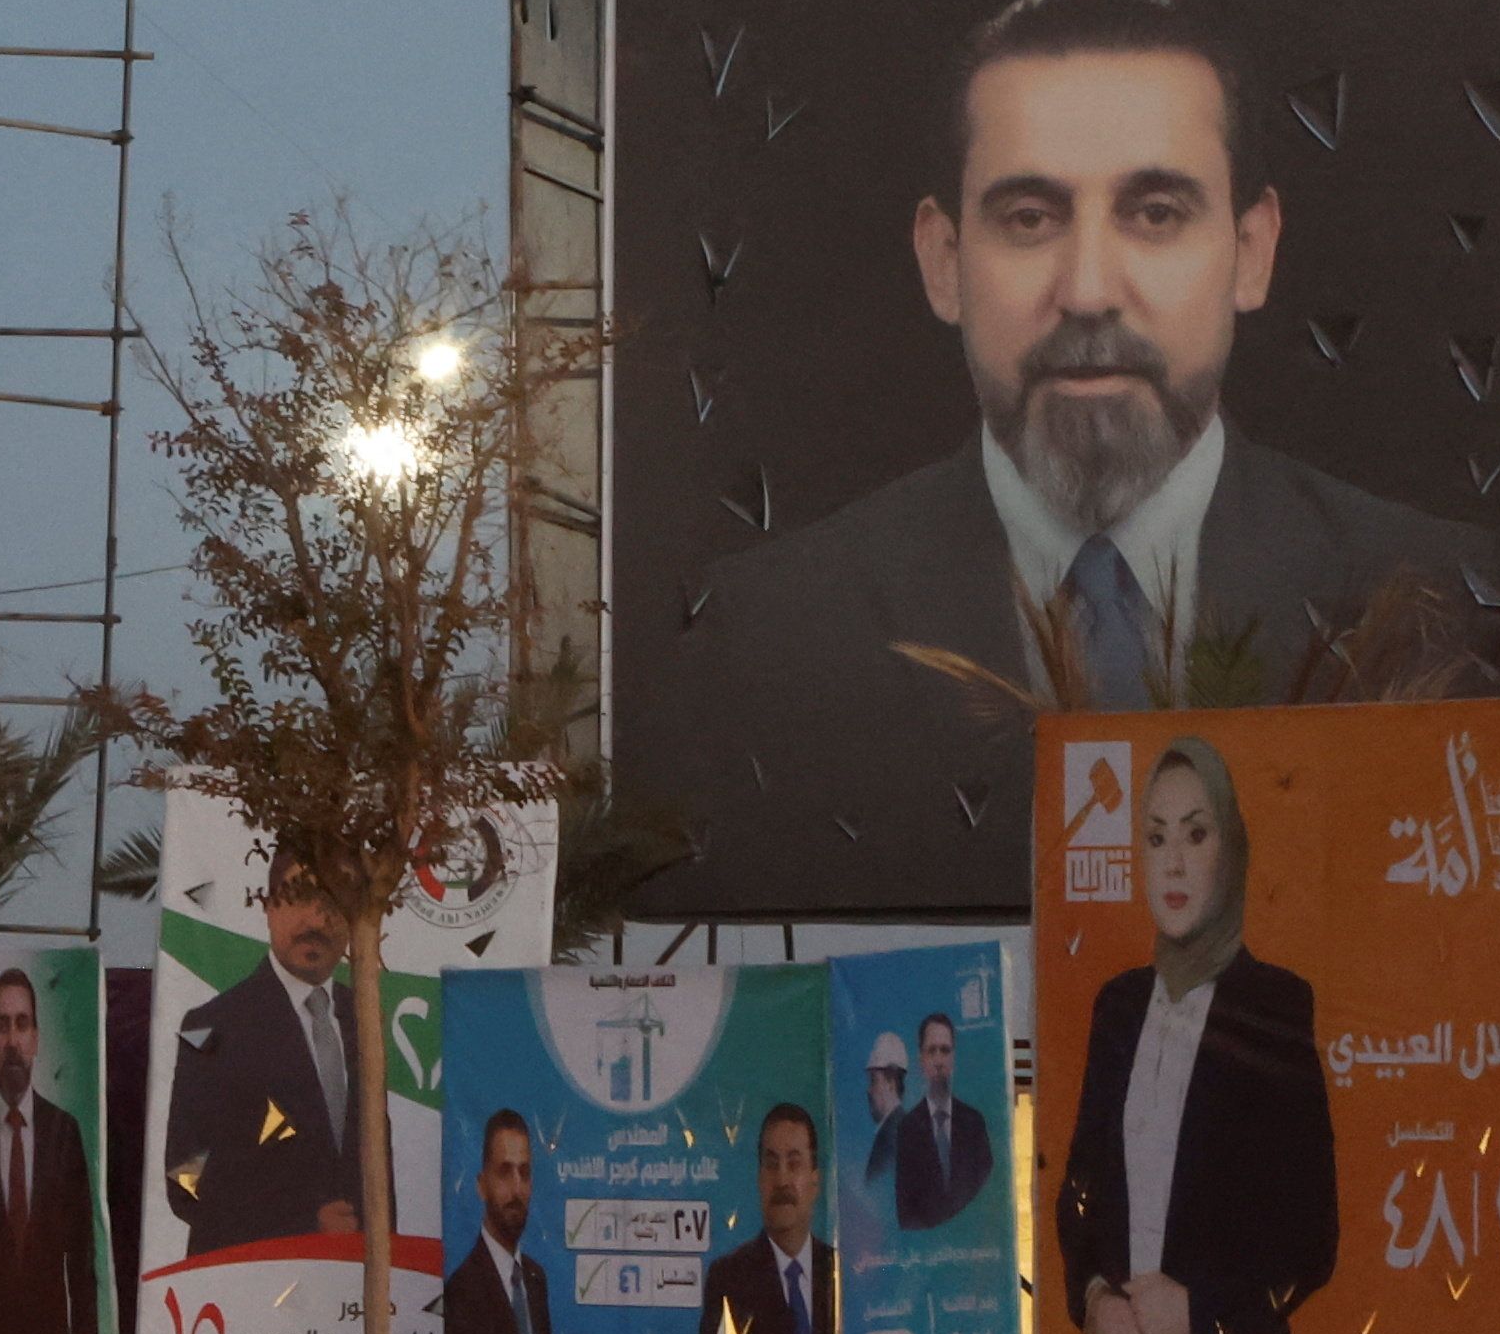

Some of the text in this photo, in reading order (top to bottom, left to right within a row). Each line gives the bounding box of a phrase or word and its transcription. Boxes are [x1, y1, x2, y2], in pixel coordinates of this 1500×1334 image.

[1327, 1021, 1453, 1087] العبيدي
[674, 1209, 708, 1242] ٢٠٧
[1383, 1168, 1466, 1270] ٤٨
[338, 1300, 397, 1323] دور
